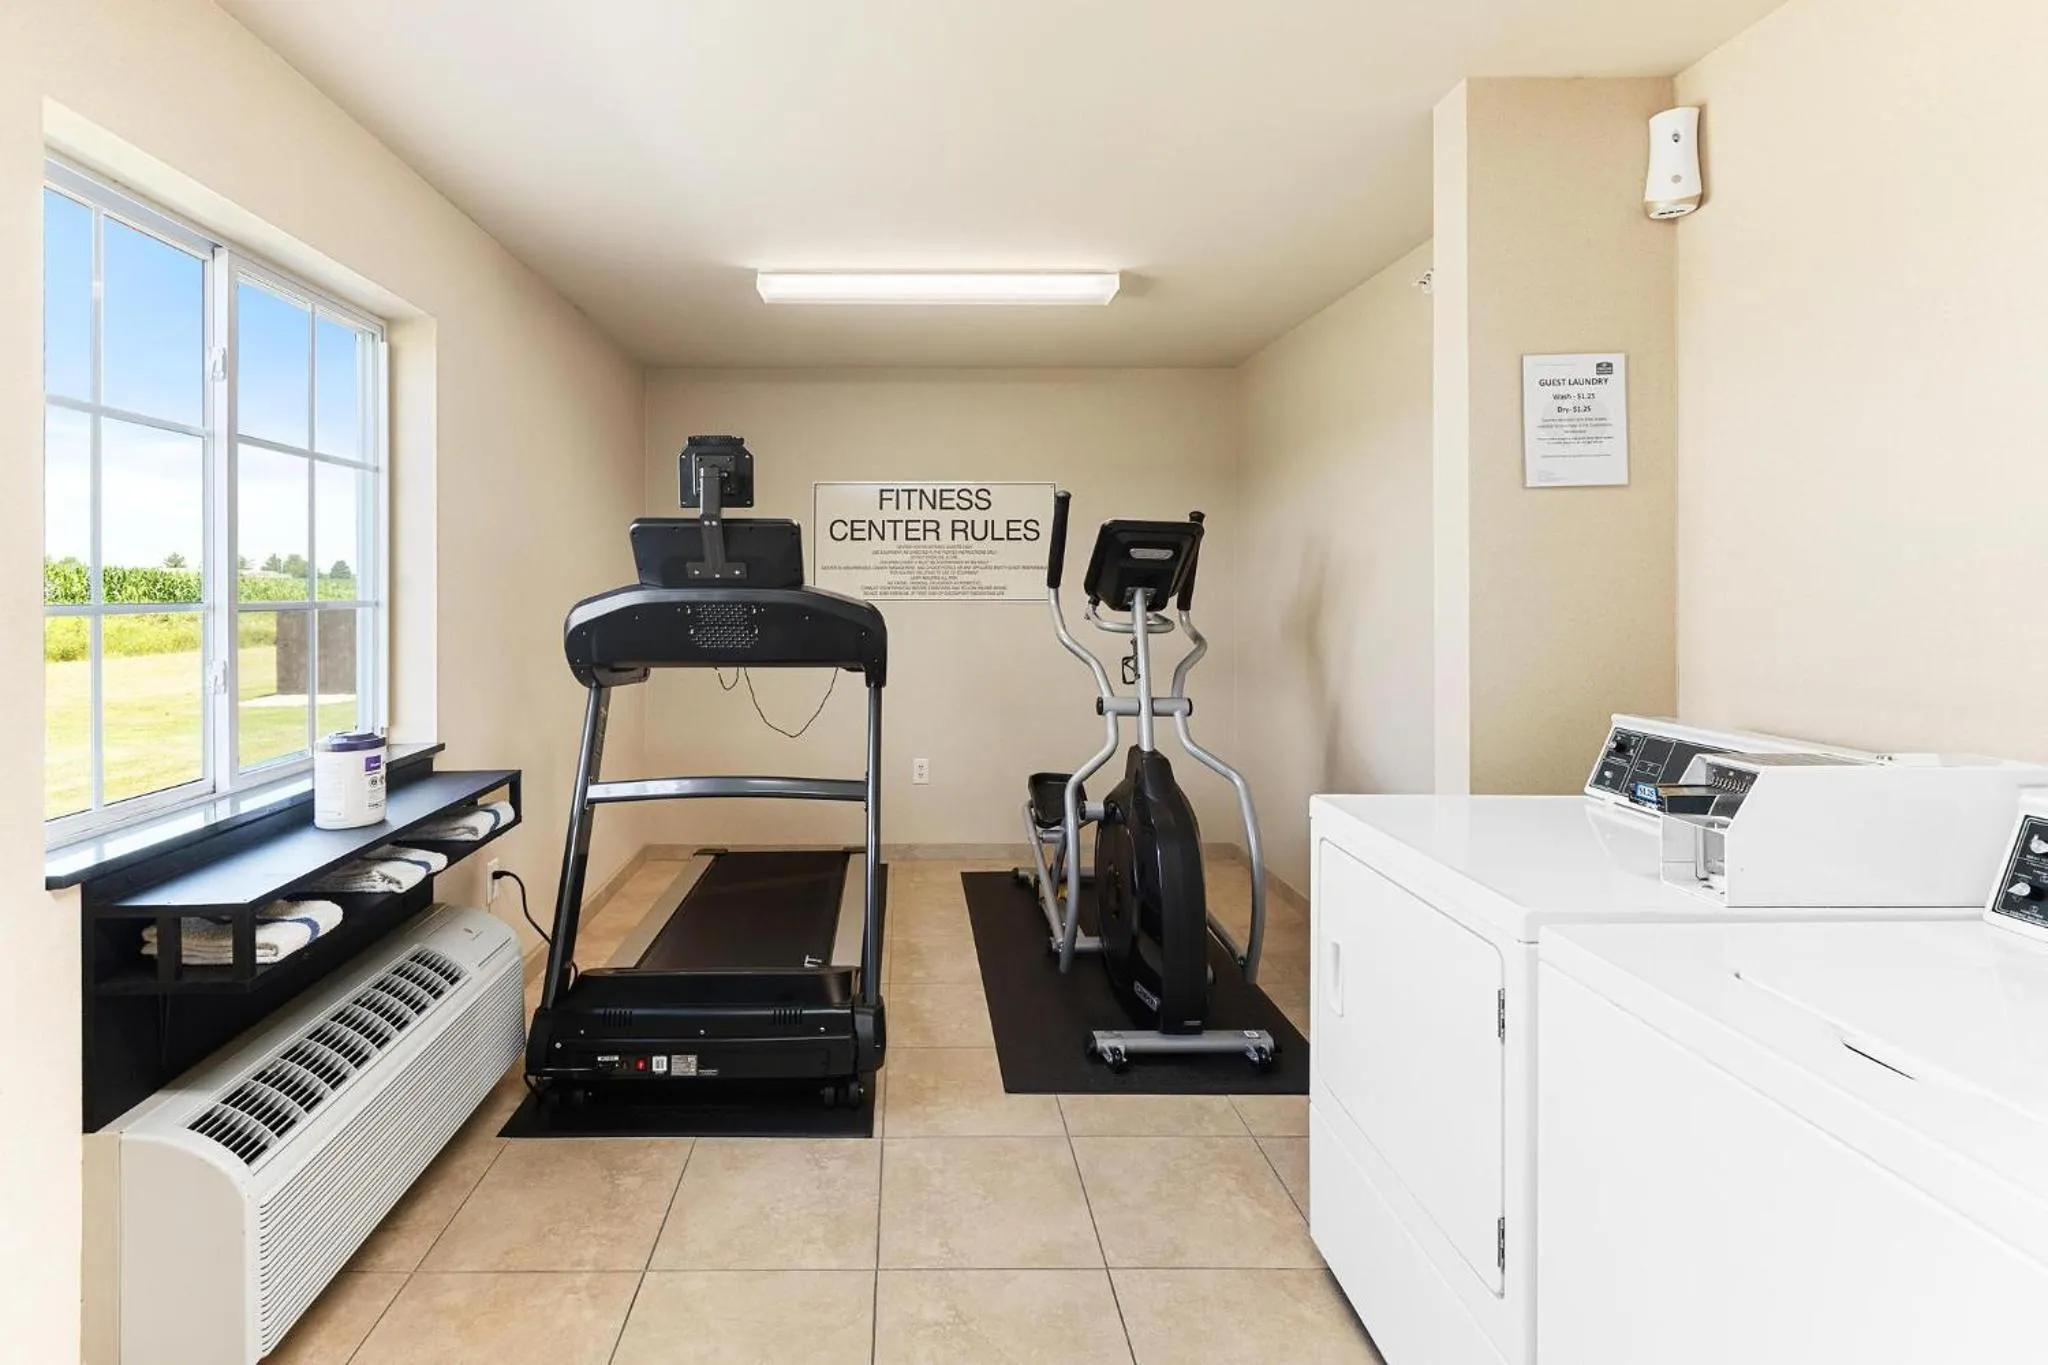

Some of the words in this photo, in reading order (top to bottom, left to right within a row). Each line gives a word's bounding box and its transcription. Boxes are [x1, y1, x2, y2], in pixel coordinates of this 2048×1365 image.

[1539, 378, 1566, 387] GUEST
[1568, 377, 1609, 386] LAUNDRY
[879, 488, 992, 511] FITNESS
[829, 518, 940, 542] CENTER
[951, 518, 1041, 542] RULES
